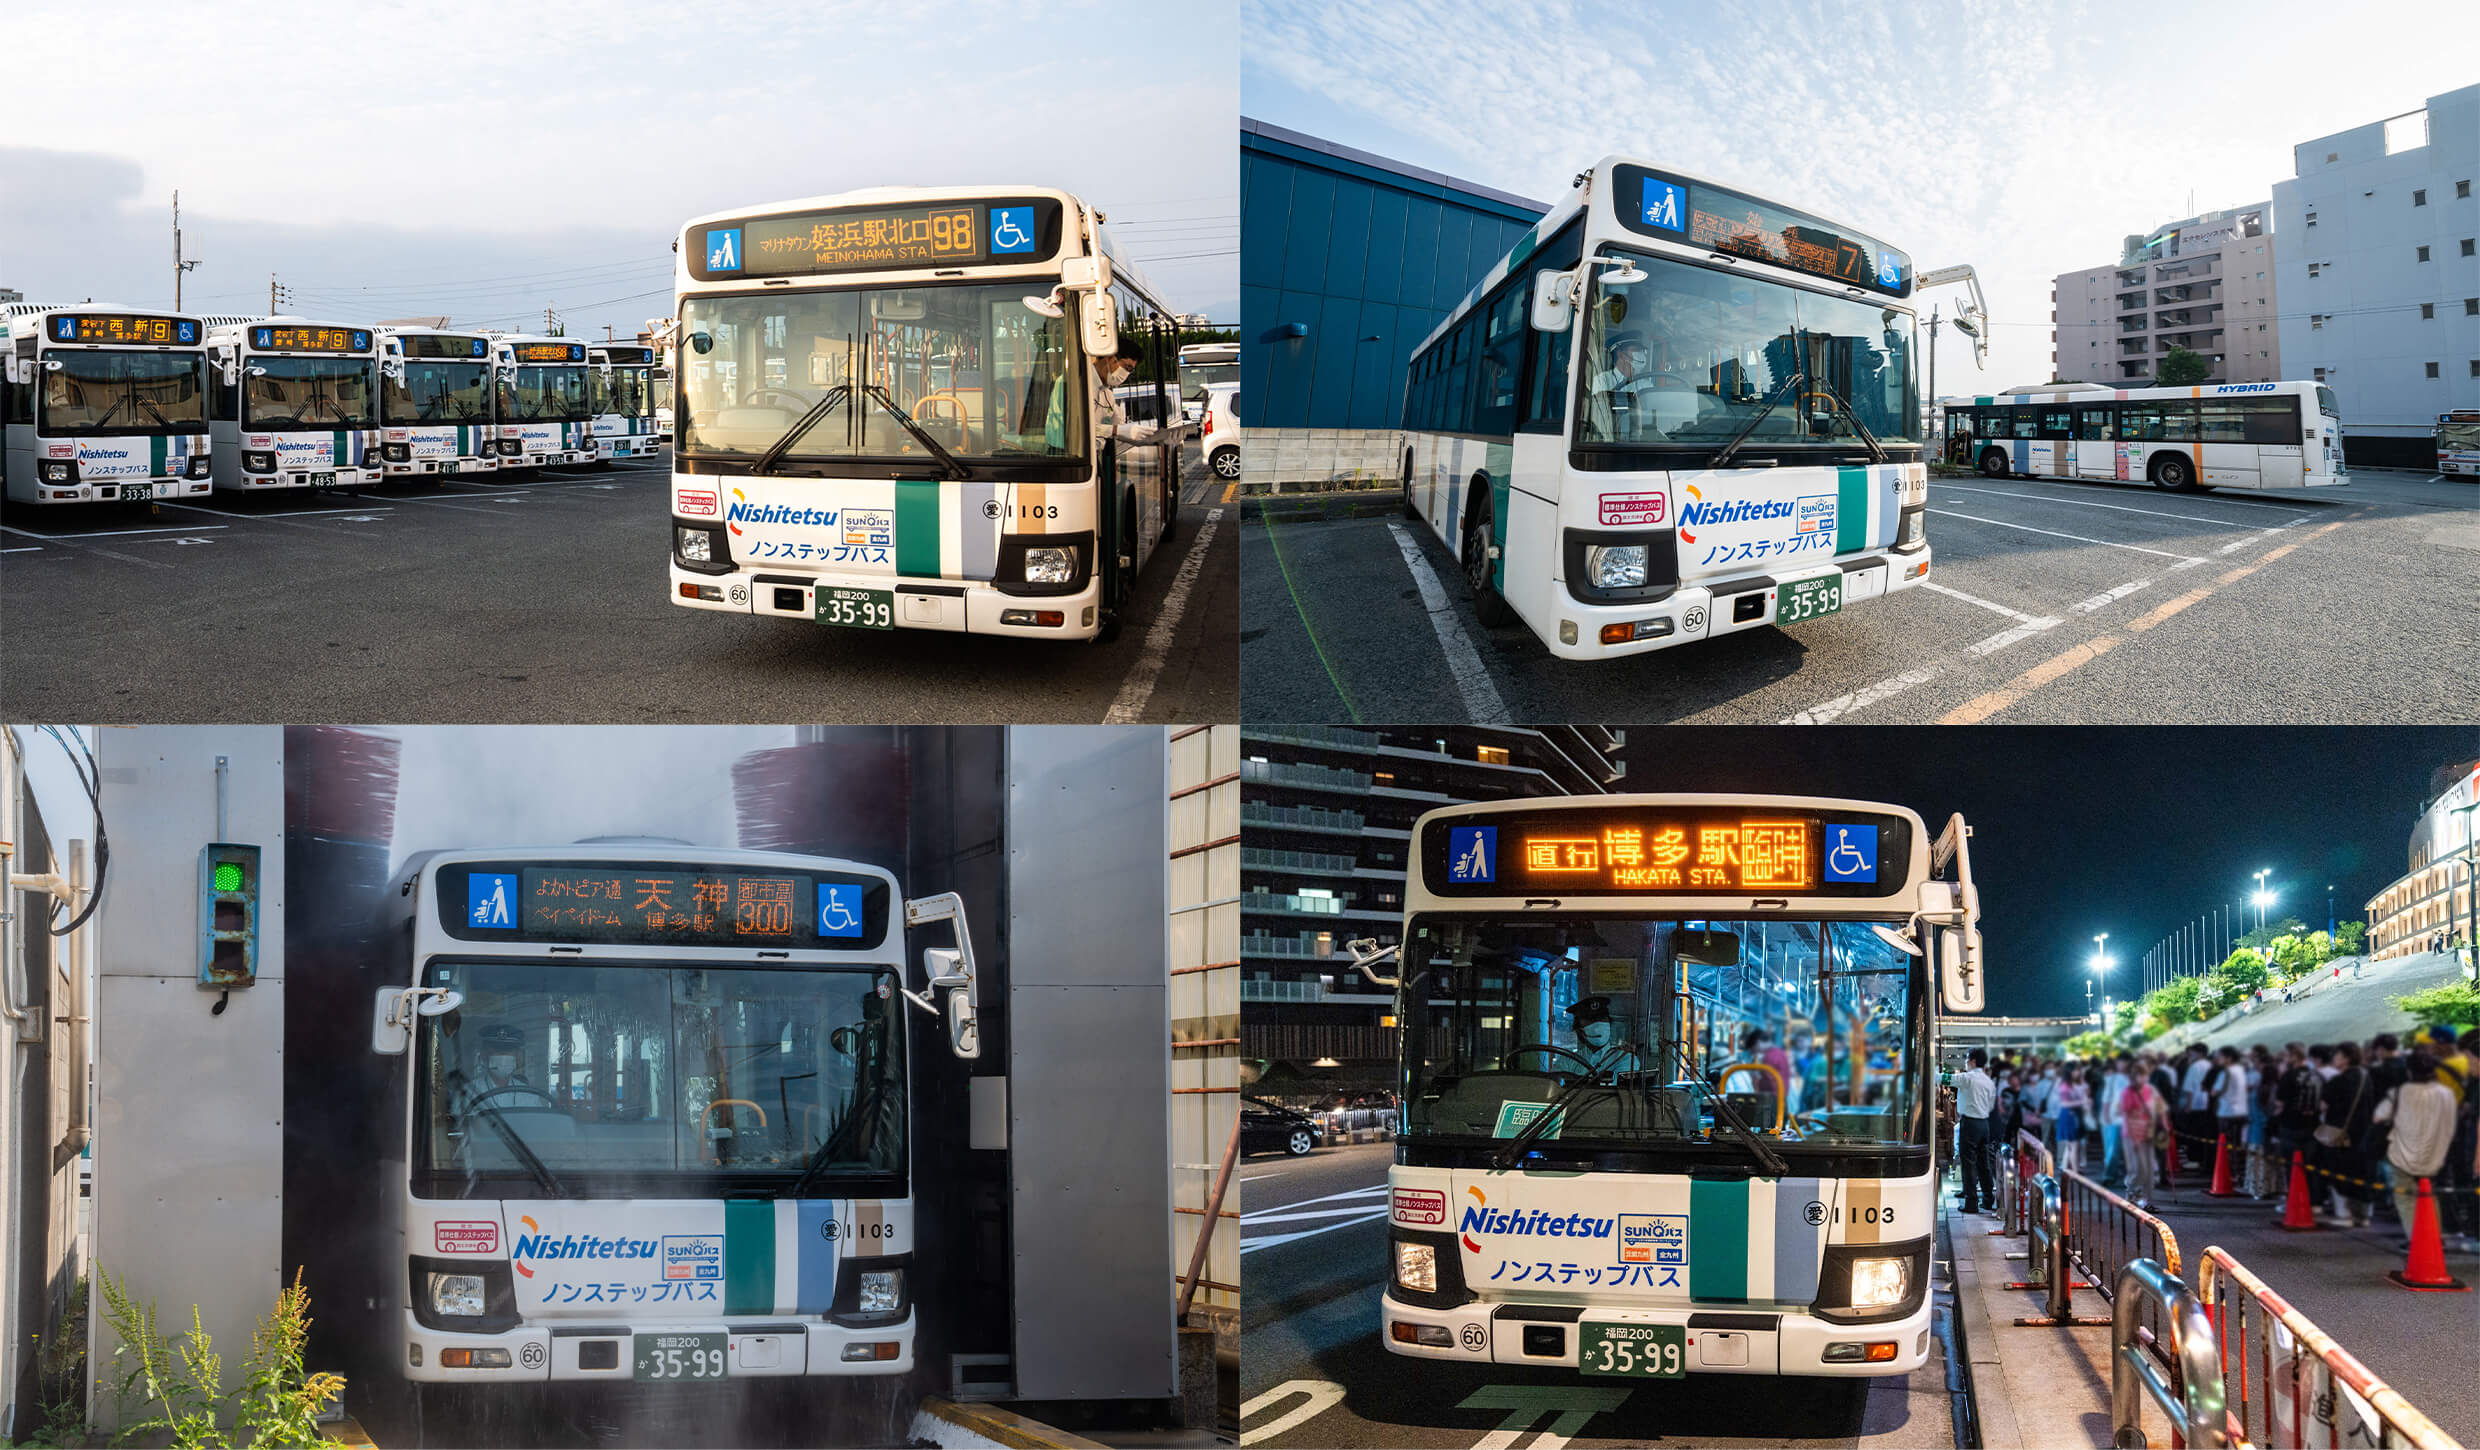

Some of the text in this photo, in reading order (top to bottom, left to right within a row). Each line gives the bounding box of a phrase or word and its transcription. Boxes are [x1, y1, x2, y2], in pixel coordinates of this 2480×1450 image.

[811, 218, 930, 250] 姪浜駅北口
[933, 214, 971, 251] 98
[759, 236, 813, 253] マリナタウン
[816, 248, 894, 264] MEINOHAMA
[1842, 246, 1858, 275] 7
[154, 323, 166, 338] 9
[2217, 384, 2276, 393] HYBRID
[78, 449, 129, 459] Nishitetsu
[275, 442, 316, 451] Nishitetsu
[88, 465, 149, 475] ノンステップバス
[315, 476, 335, 486] 48-53
[1904, 480, 1925, 491] 1103
[126, 488, 152, 500] 33-38
[727, 502, 838, 526] Nishitetsu
[1008, 505, 1058, 519] 1103
[1677, 499, 1795, 527] Nishitetsu
[749, 541, 889, 564] ノンステップバス
[1701, 532, 1832, 565] ノンステップバス
[731, 589, 747, 601] 60
[1789, 586, 1840, 621] 35-99
[828, 600, 890, 627] 35-99
[1684, 611, 1704, 627] 60
[1532, 844, 1595, 867] 直行
[1604, 828, 1740, 865] 博多駅
[1744, 829, 1800, 880] 臨時
[1614, 869, 1731, 885] HAKATA STA.
[634, 879, 729, 912] 天神
[741, 882, 791, 900] 都市高
[646, 912, 715, 932] 博多駅
[740, 902, 788, 932] 300
[1459, 1206, 1614, 1238] Nishitetsu
[1835, 1207, 1894, 1224] 1103
[847, 1224, 893, 1239] 1103
[513, 1234, 658, 1259] Nishitetsu
[1490, 1260, 1680, 1287] ノンステップバス
[542, 1281, 717, 1303] ノンステップバス
[1463, 1330, 1485, 1345] 60
[522, 1349, 543, 1363] 60
[651, 1349, 723, 1378] 35-99
[1584, 1341, 1680, 1375] か 35-99
